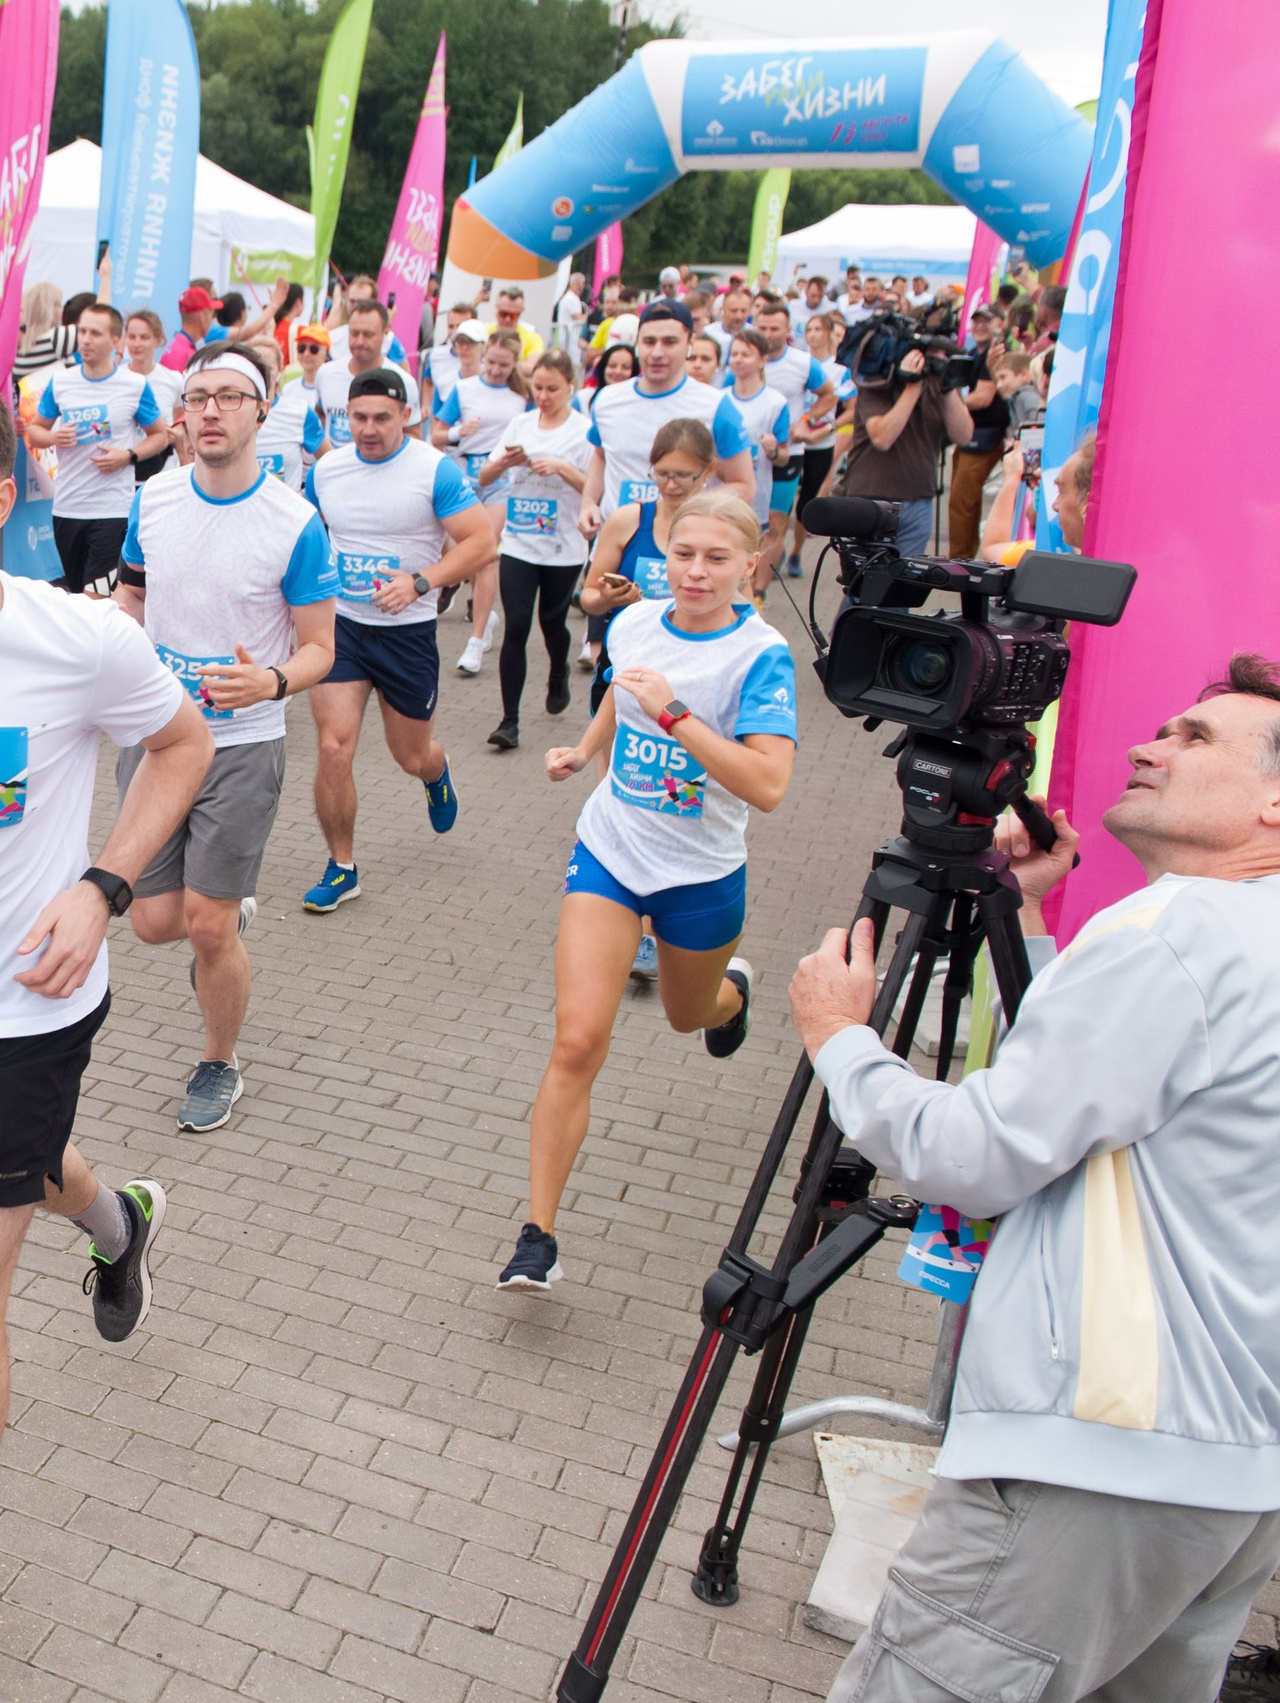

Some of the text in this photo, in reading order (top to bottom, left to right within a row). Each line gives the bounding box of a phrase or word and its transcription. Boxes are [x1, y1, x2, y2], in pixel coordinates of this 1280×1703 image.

[719, 56, 814, 105] ЗАБЕГ
[67, 407, 101, 423] 3269
[513, 500, 549, 515] 3202
[624, 733, 688, 771] 3015
[915, 762, 949, 775] CARTONI
[909, 786, 940, 798] FOCUS
[919, 1270, 951, 1289] ПРЕССА
